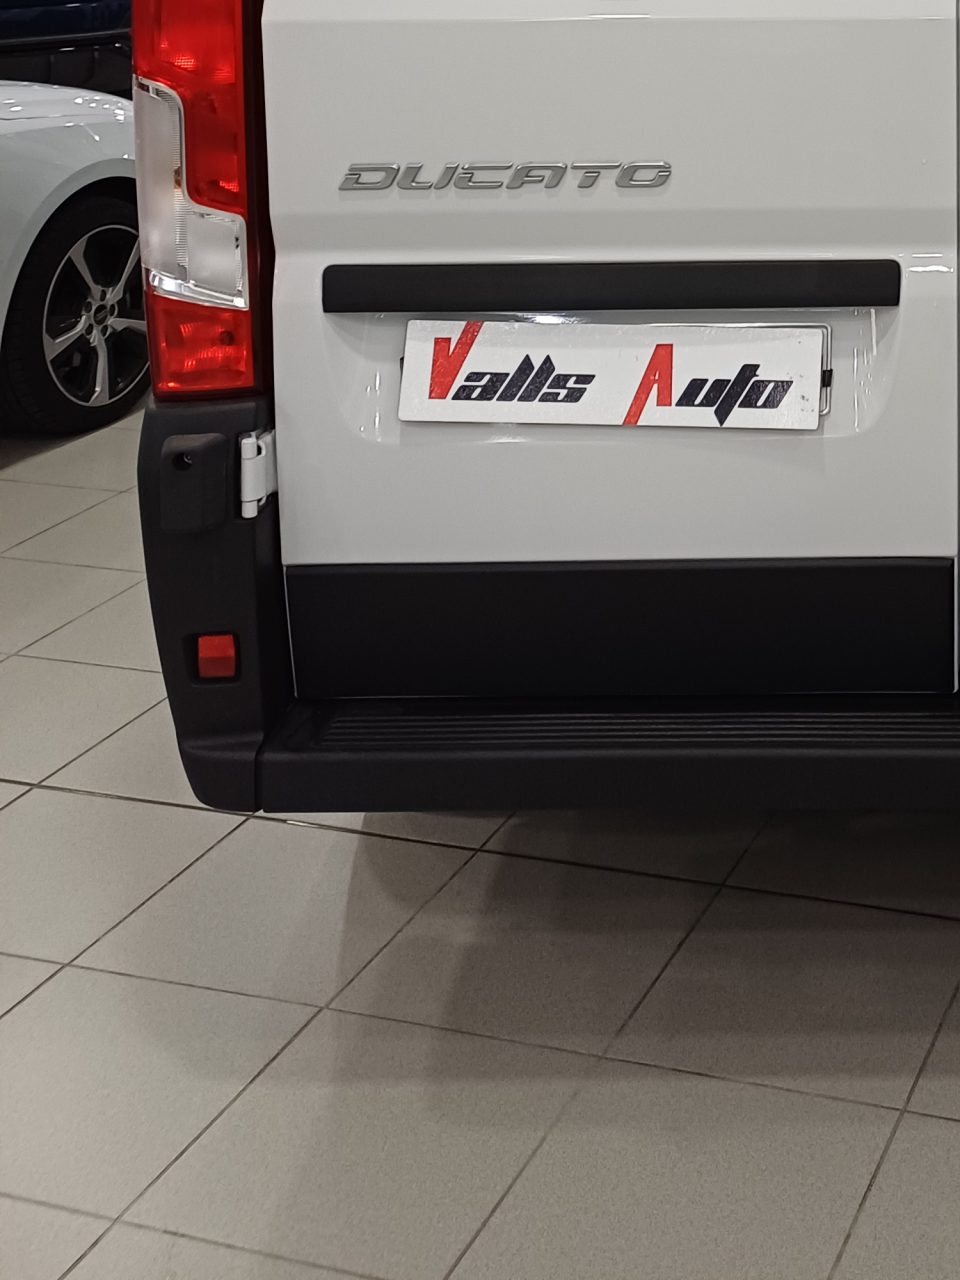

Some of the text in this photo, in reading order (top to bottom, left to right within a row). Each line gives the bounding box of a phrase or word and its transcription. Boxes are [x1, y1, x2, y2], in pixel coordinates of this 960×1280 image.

[338, 161, 672, 191] DUCATO
[428, 320, 794, 427] Valls Auto
